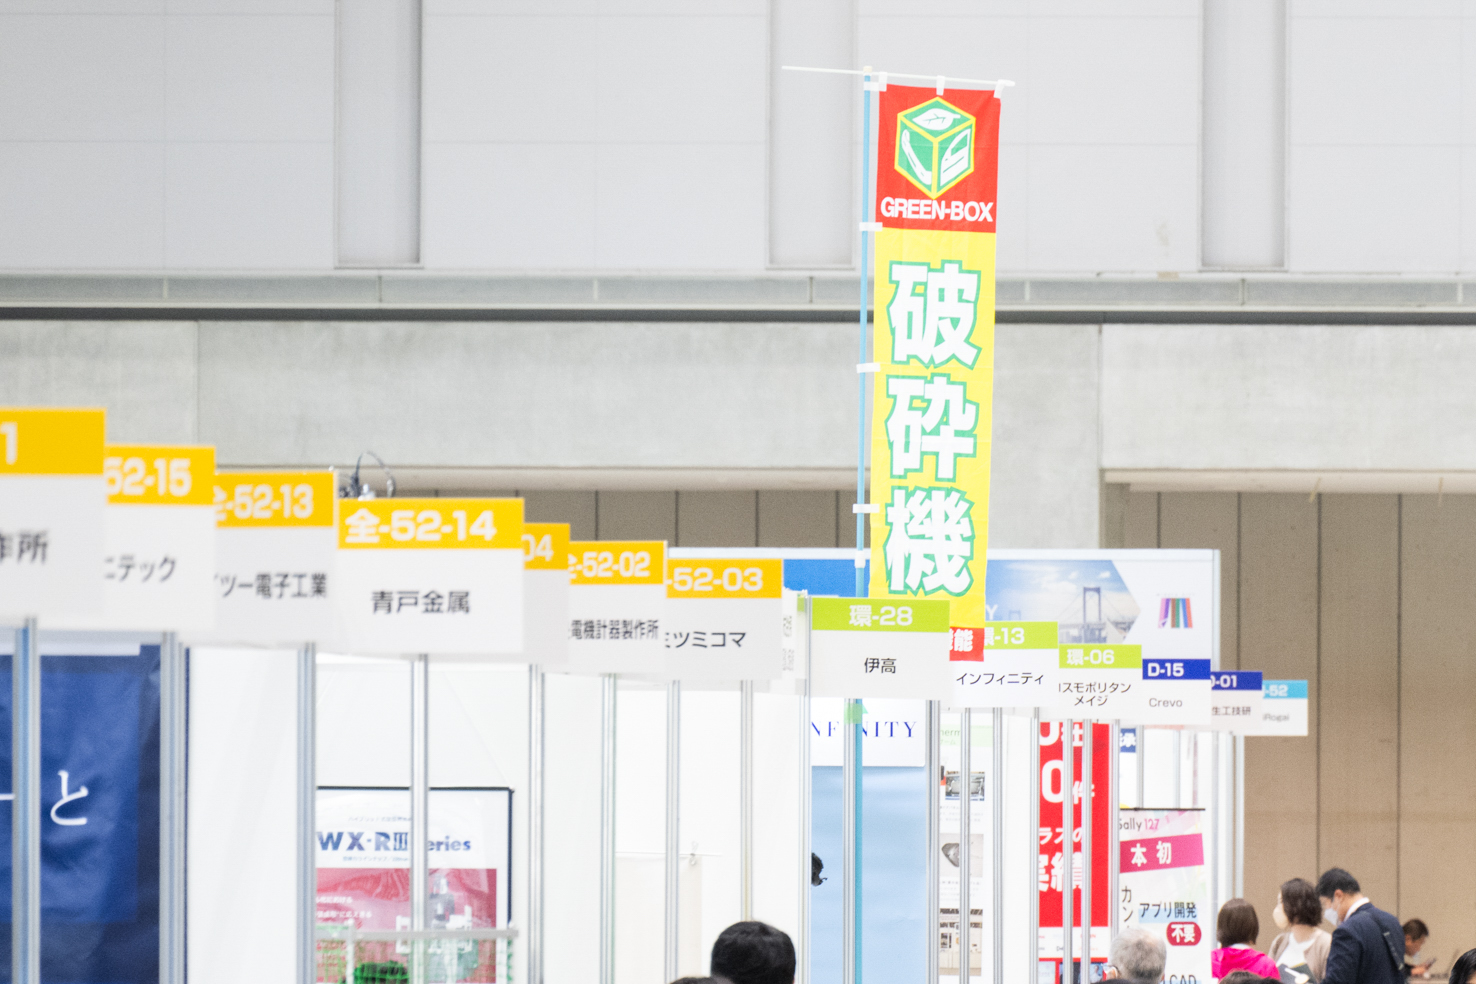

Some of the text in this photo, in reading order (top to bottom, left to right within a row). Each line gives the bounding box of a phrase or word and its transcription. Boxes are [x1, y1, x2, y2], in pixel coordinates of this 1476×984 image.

[881, 197, 993, 222] GREEN-BOX
[884, 259, 982, 597] 破砕機
[345, 507, 497, 544] 全-52-14
[214, 572, 327, 599] ツー電子工業
[371, 590, 470, 614] 青戸金属
[848, 604, 914, 627] 環-28
[569, 619, 659, 640] 電機計器製作所
[864, 657, 897, 674] 伊高
[1067, 648, 1115, 666] 環-06
[956, 672, 1044, 686] インフィニティ
[1148, 662, 1185, 678] D-15
[1074, 694, 1108, 707] メイジ
[1149, 697, 1183, 708] Crevo
[427, 835, 471, 852] eries
[1139, 901, 1197, 919] アプリ開発
[1170, 923, 1196, 943] 不要
